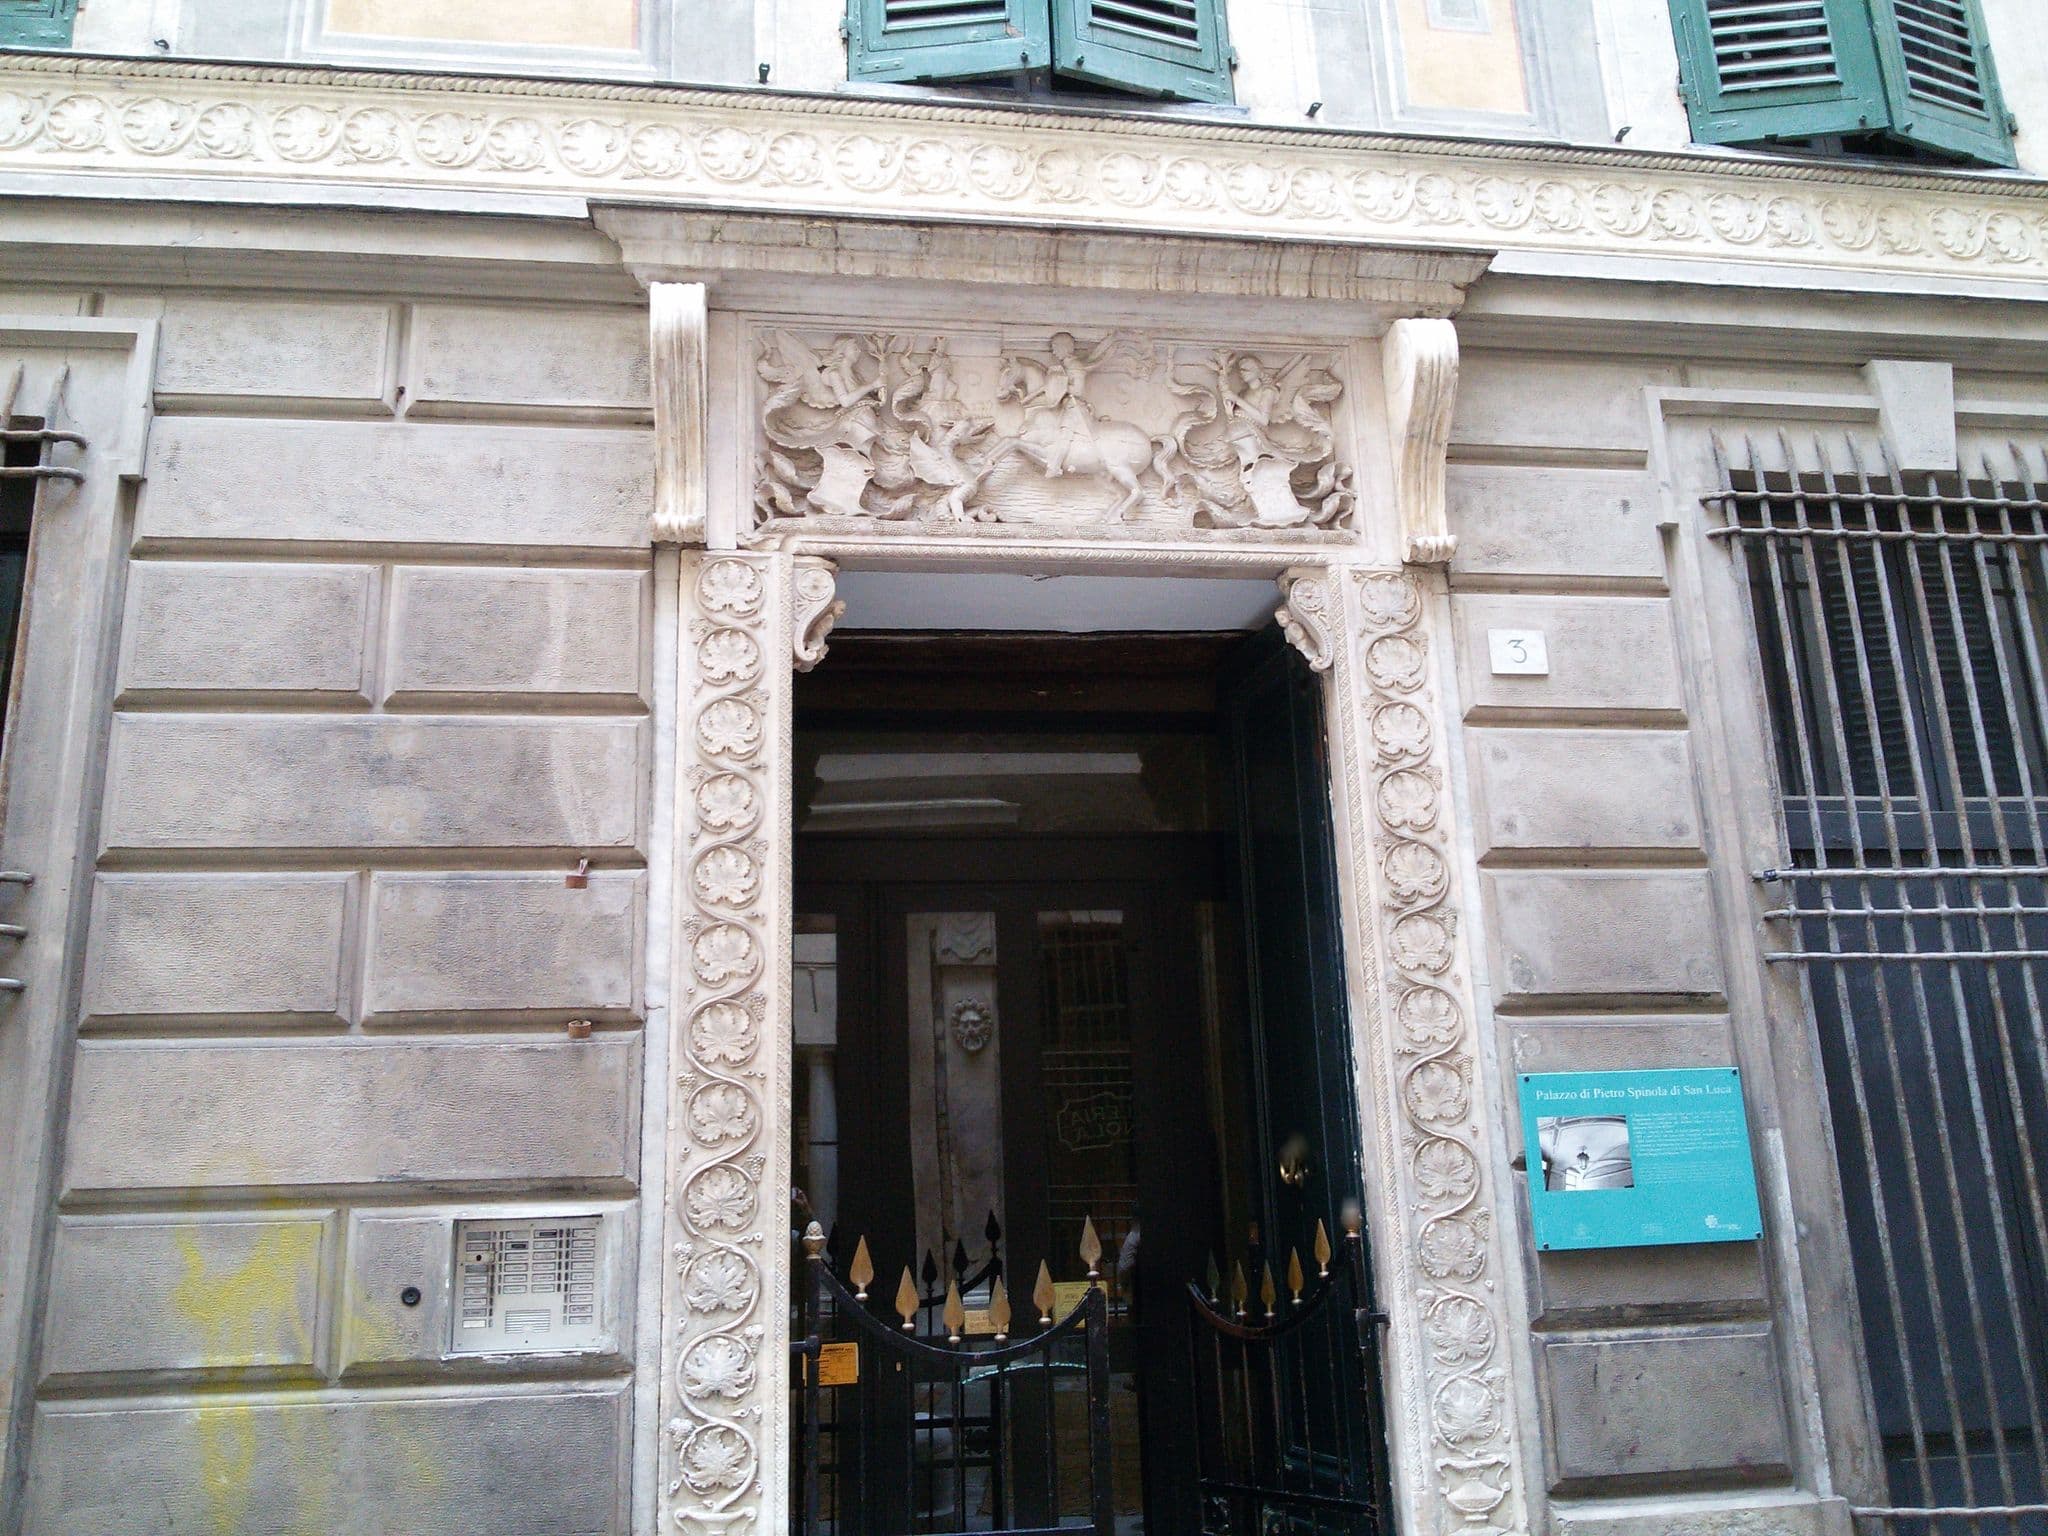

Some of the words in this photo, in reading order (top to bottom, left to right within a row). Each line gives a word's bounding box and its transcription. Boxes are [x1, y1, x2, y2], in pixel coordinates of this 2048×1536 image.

[1506, 638, 1528, 664] 3
[1535, 1089, 1578, 1101] Palazzo
[1580, 1088, 1591, 1099] di
[1594, 1087, 1625, 1099] Pietro
[1627, 1086, 1667, 1099] Spinola
[1670, 1085, 1680, 1095] di
[1683, 1085, 1703, 1095] San
[1705, 1084, 1733, 1095] Luca
